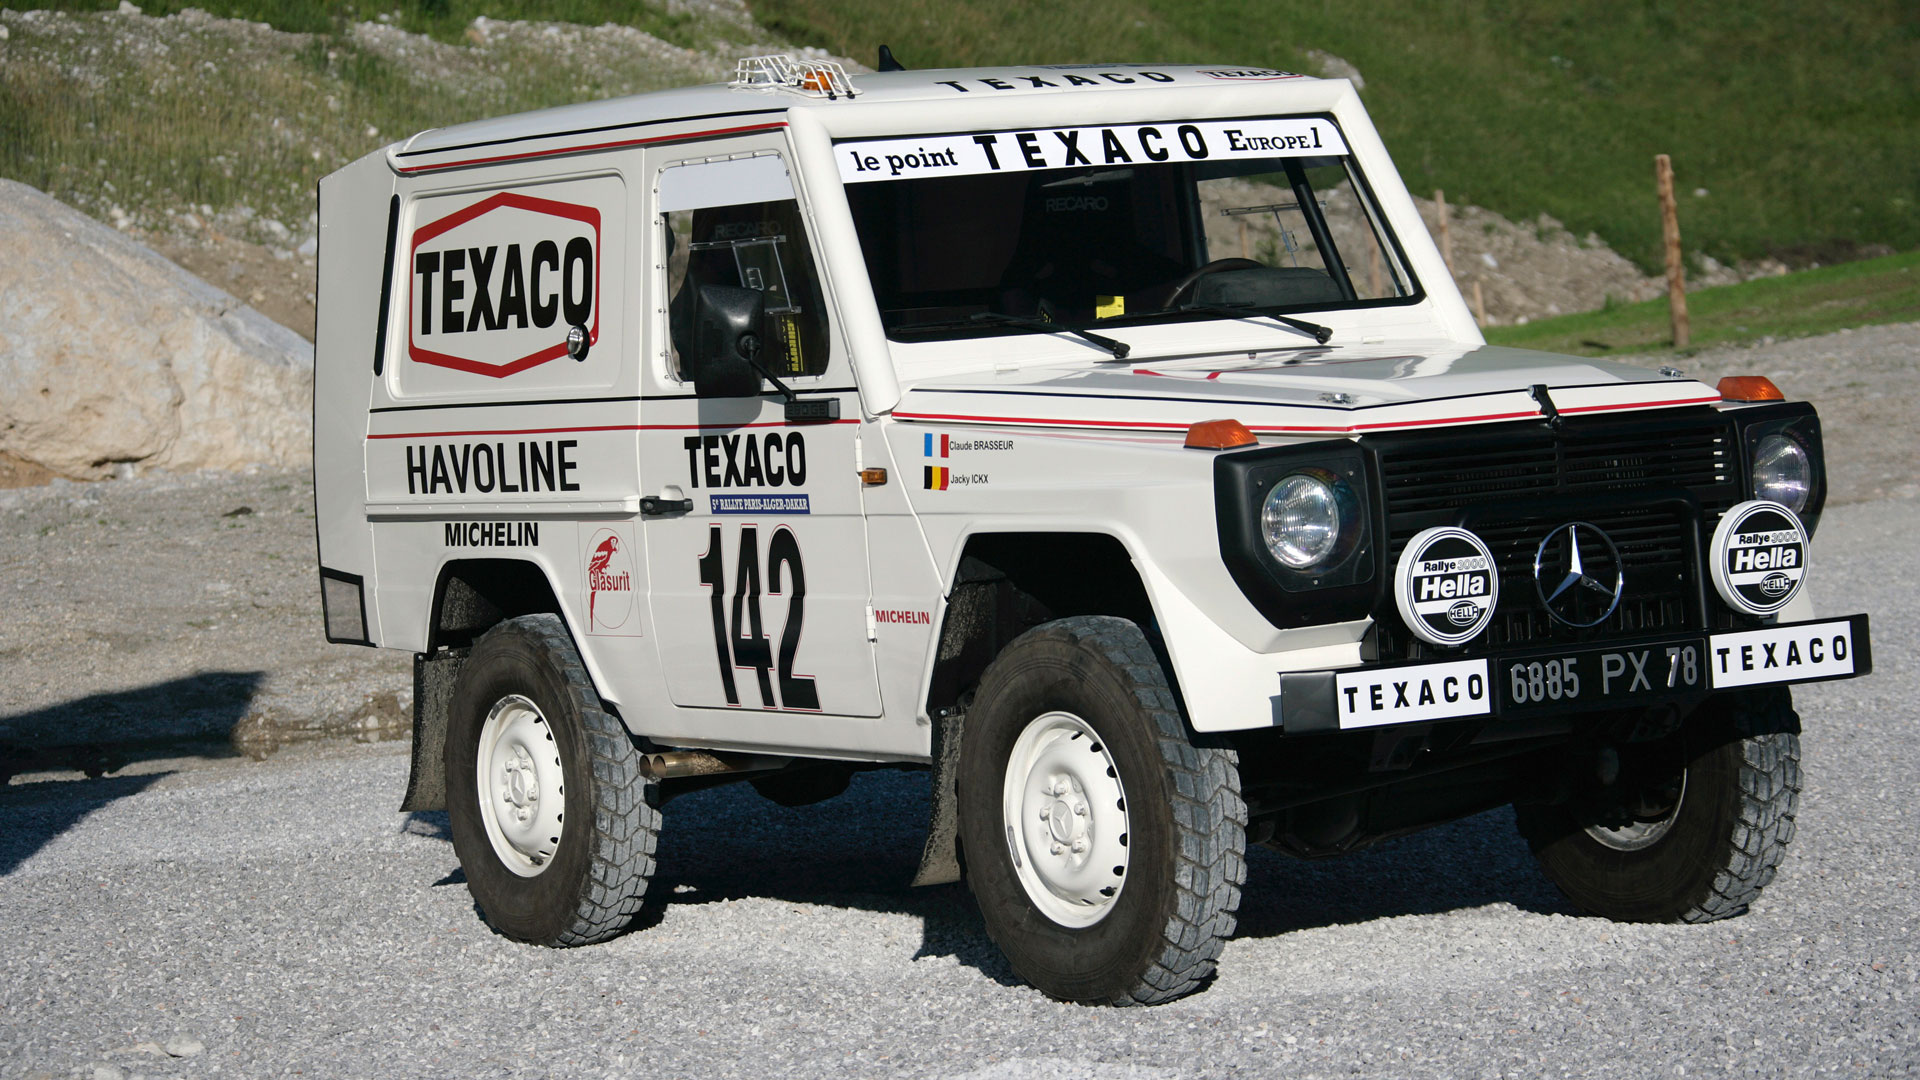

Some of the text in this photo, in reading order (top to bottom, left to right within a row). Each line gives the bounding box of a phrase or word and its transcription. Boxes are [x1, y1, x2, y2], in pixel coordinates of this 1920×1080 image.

[936, 72, 1175, 93] TEXACO
[850, 151, 880, 171] le
[885, 147, 958, 175] point
[973, 125, 1209, 169] TEXACO
[1046, 196, 1109, 212] RECARO
[415, 237, 593, 336] TEXACO
[949, 440, 1014, 450] Claude BRASSEUR
[407, 440, 580, 494] HAVOLINE
[684, 432, 807, 488] TEXACO
[950, 474, 988, 486] Jacky ICKX
[720, 499, 743, 510] RALLYE
[744, 498, 808, 510] PARIS-ALGER-DAKAR
[445, 523, 538, 546] MICHELIN
[1739, 531, 1799, 545] Rallye 3000
[1423, 557, 1486, 573] Rallye 3000
[1735, 547, 1797, 571] Hella
[589, 570, 630, 591] Glasurit
[1420, 574, 1485, 600] Hella
[1763, 577, 1790, 589] HELLA
[699, 523, 822, 712] 142
[875, 610, 930, 625] MICHELIN
[1450, 606, 1479, 618] HELLA
[1716, 635, 1847, 674] TEXACO
[1510, 646, 1697, 704] 6885 PX 78
[1344, 674, 1483, 713] TEXACO
